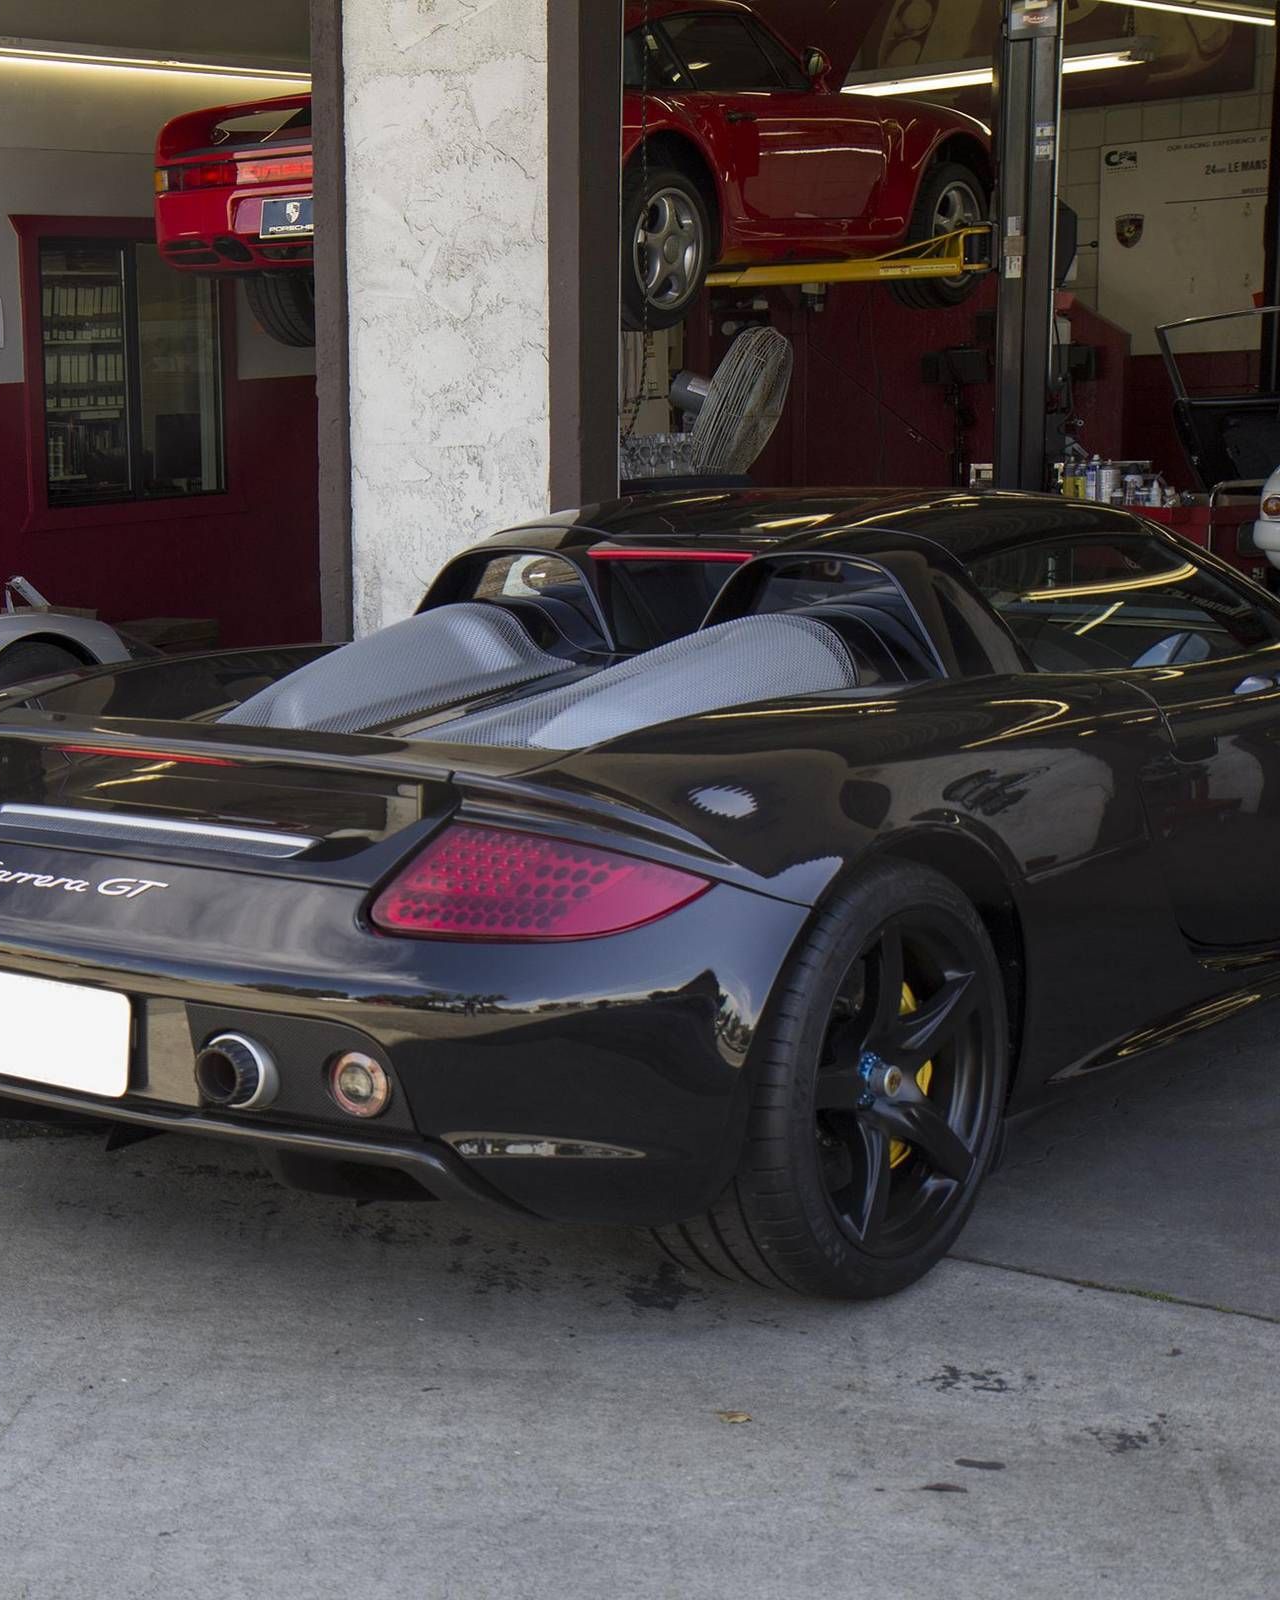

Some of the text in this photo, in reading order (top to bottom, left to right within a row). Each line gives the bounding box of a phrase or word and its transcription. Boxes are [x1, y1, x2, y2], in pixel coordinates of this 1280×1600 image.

[1228, 161, 1240, 172] LE
[1241, 159, 1268, 171] MANS
[97, 878, 169, 898] GT
